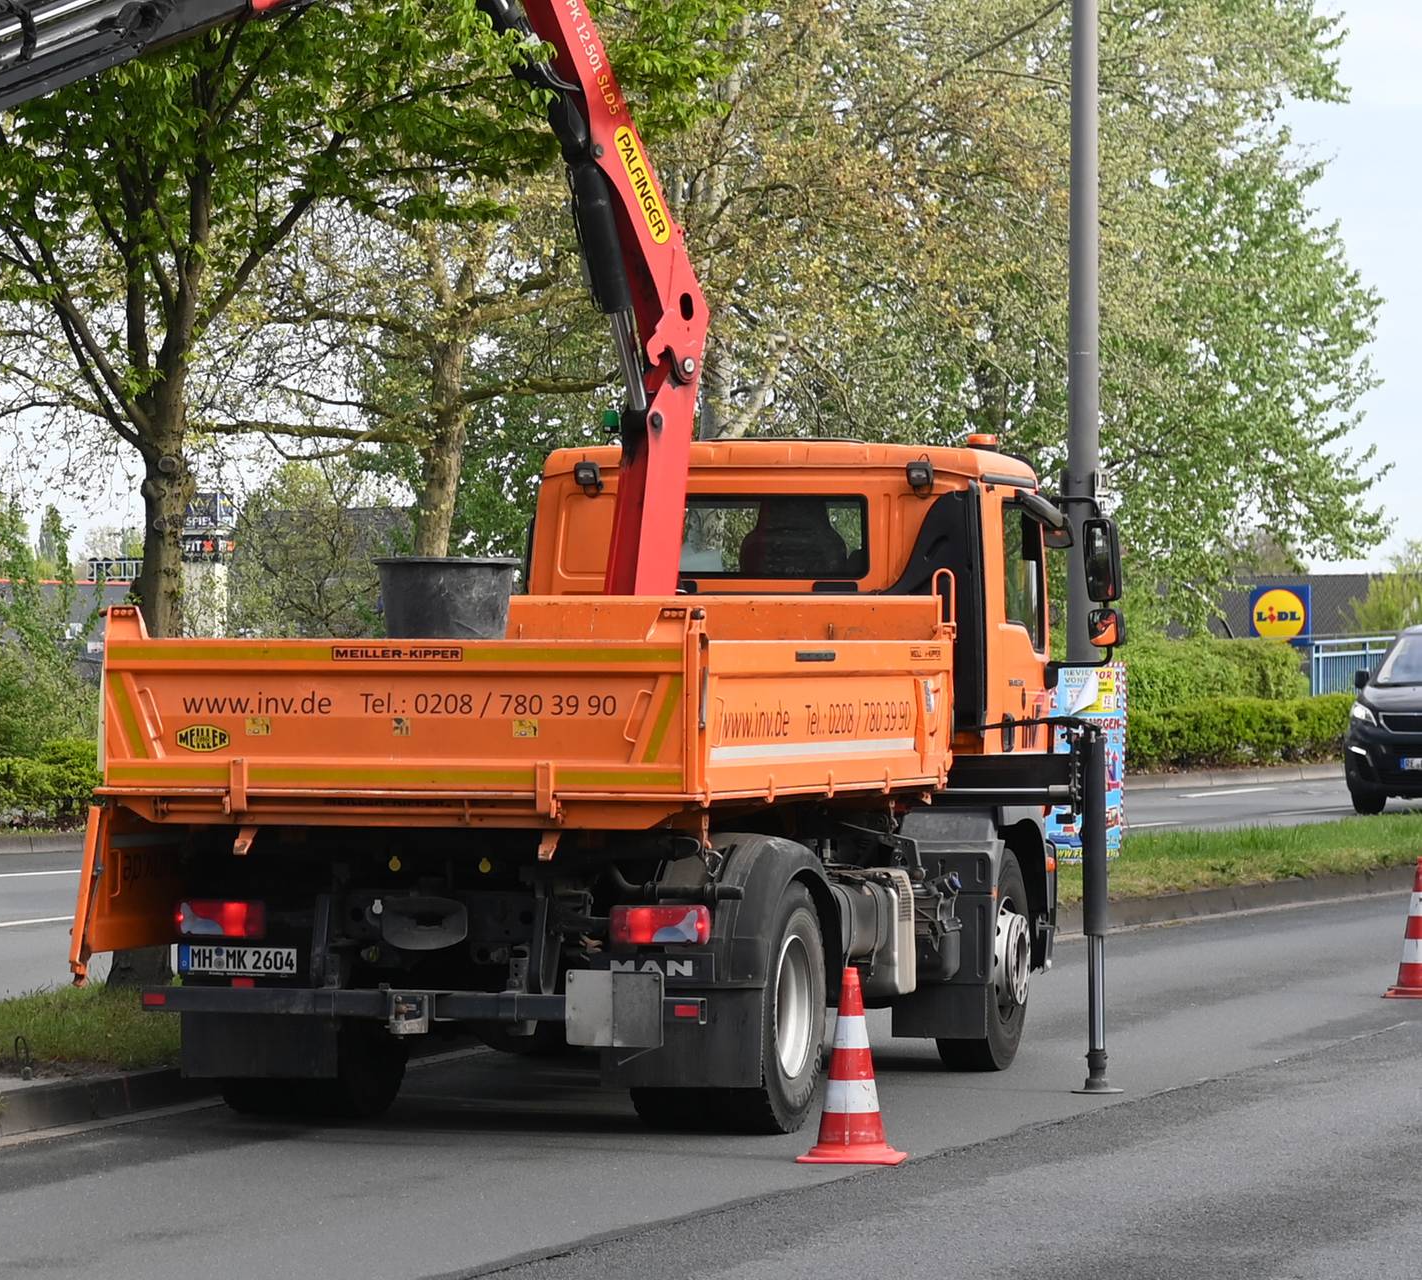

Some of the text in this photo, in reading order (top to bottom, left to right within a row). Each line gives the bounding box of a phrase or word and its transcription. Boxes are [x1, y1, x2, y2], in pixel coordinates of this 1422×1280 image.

[565, 0, 582, 22] PK
[576, 23, 603, 74] 12.501
[617, 132, 666, 237] PALFINGER
[334, 649, 460, 659] MEILLER-KIPPER
[183, 691, 617, 718] www.inv.de Tel.: 0208 / 780 39 90
[805, 704, 826, 735] Tel.:
[828, 703, 854, 735] 0208
[864, 702, 881, 732] 780
[884, 701, 897, 731] 39
[898, 701, 911, 730] 90
[179, 728, 227, 749] MEILLER
[191, 949, 294, 970] MH MK 2604
[610, 960, 693, 976] MAN
